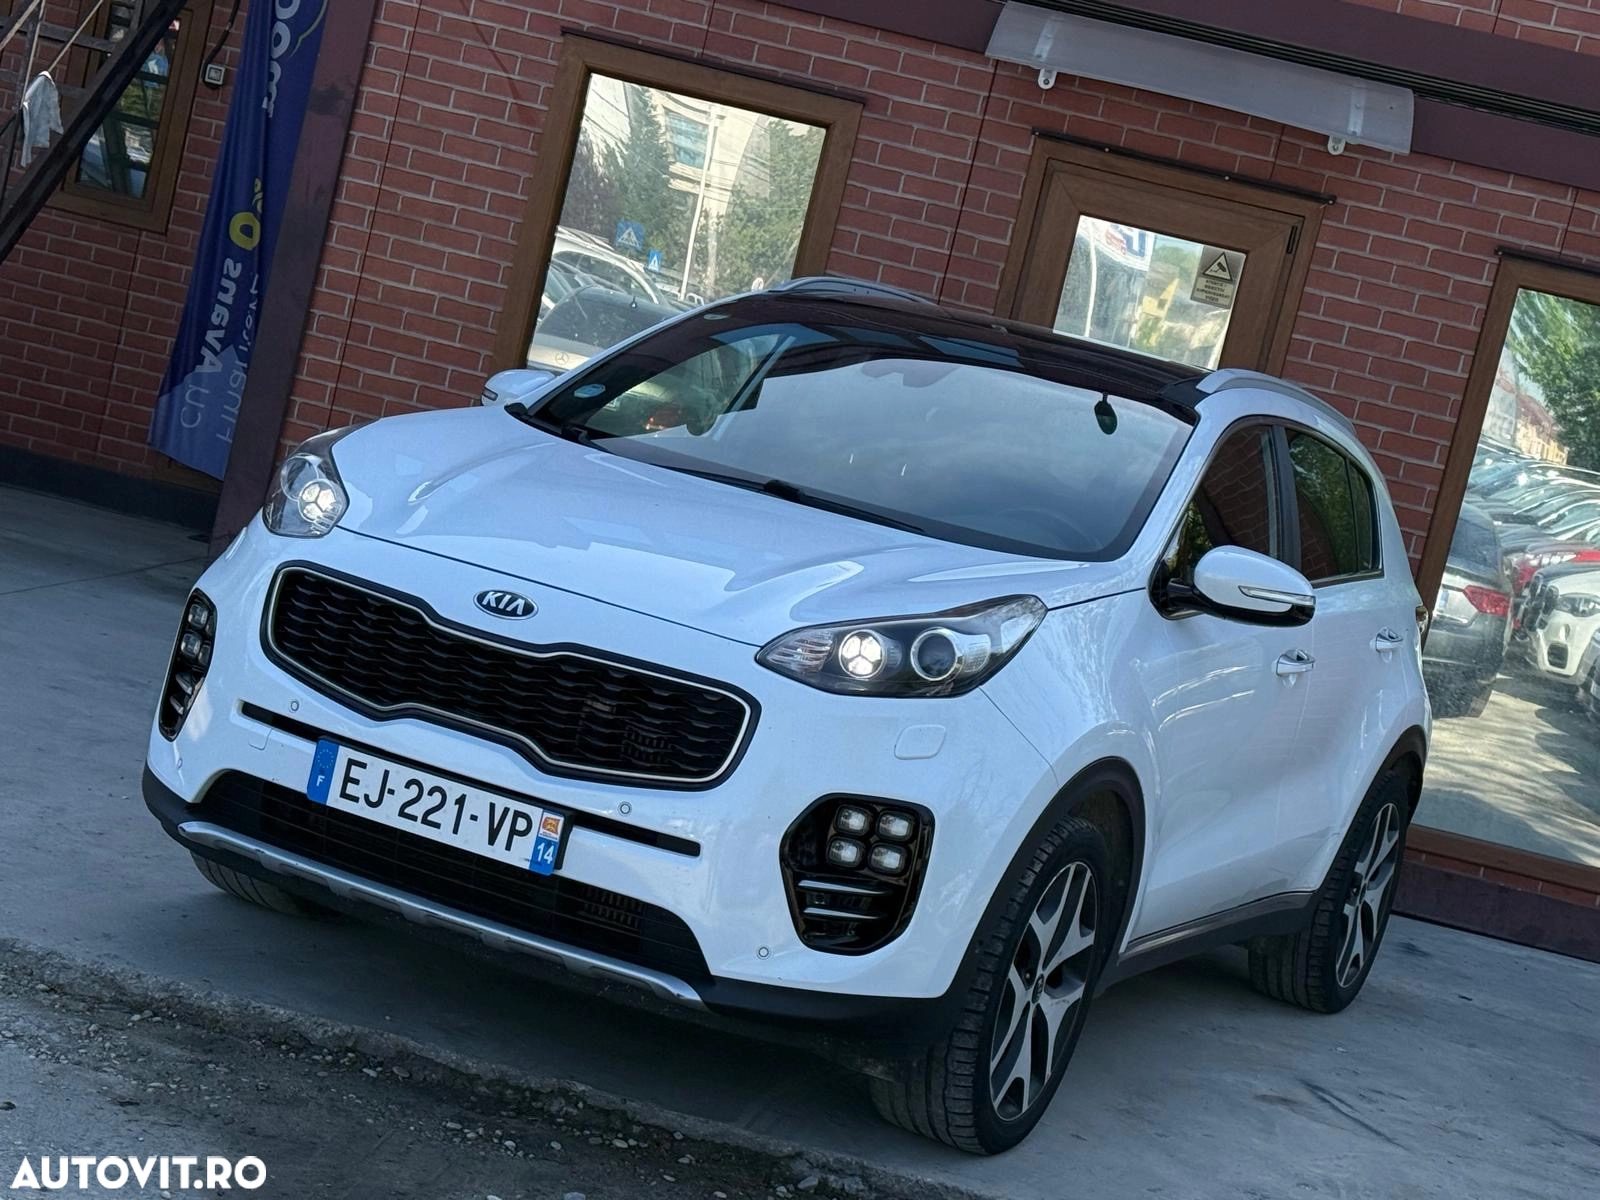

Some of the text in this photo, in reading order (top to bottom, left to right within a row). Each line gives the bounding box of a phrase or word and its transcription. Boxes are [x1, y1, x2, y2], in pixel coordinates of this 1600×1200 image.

[481, 591, 526, 615] KIA
[316, 774, 326, 787] F
[339, 757, 533, 852] EJ-221-VP
[537, 842, 555, 865] 14
